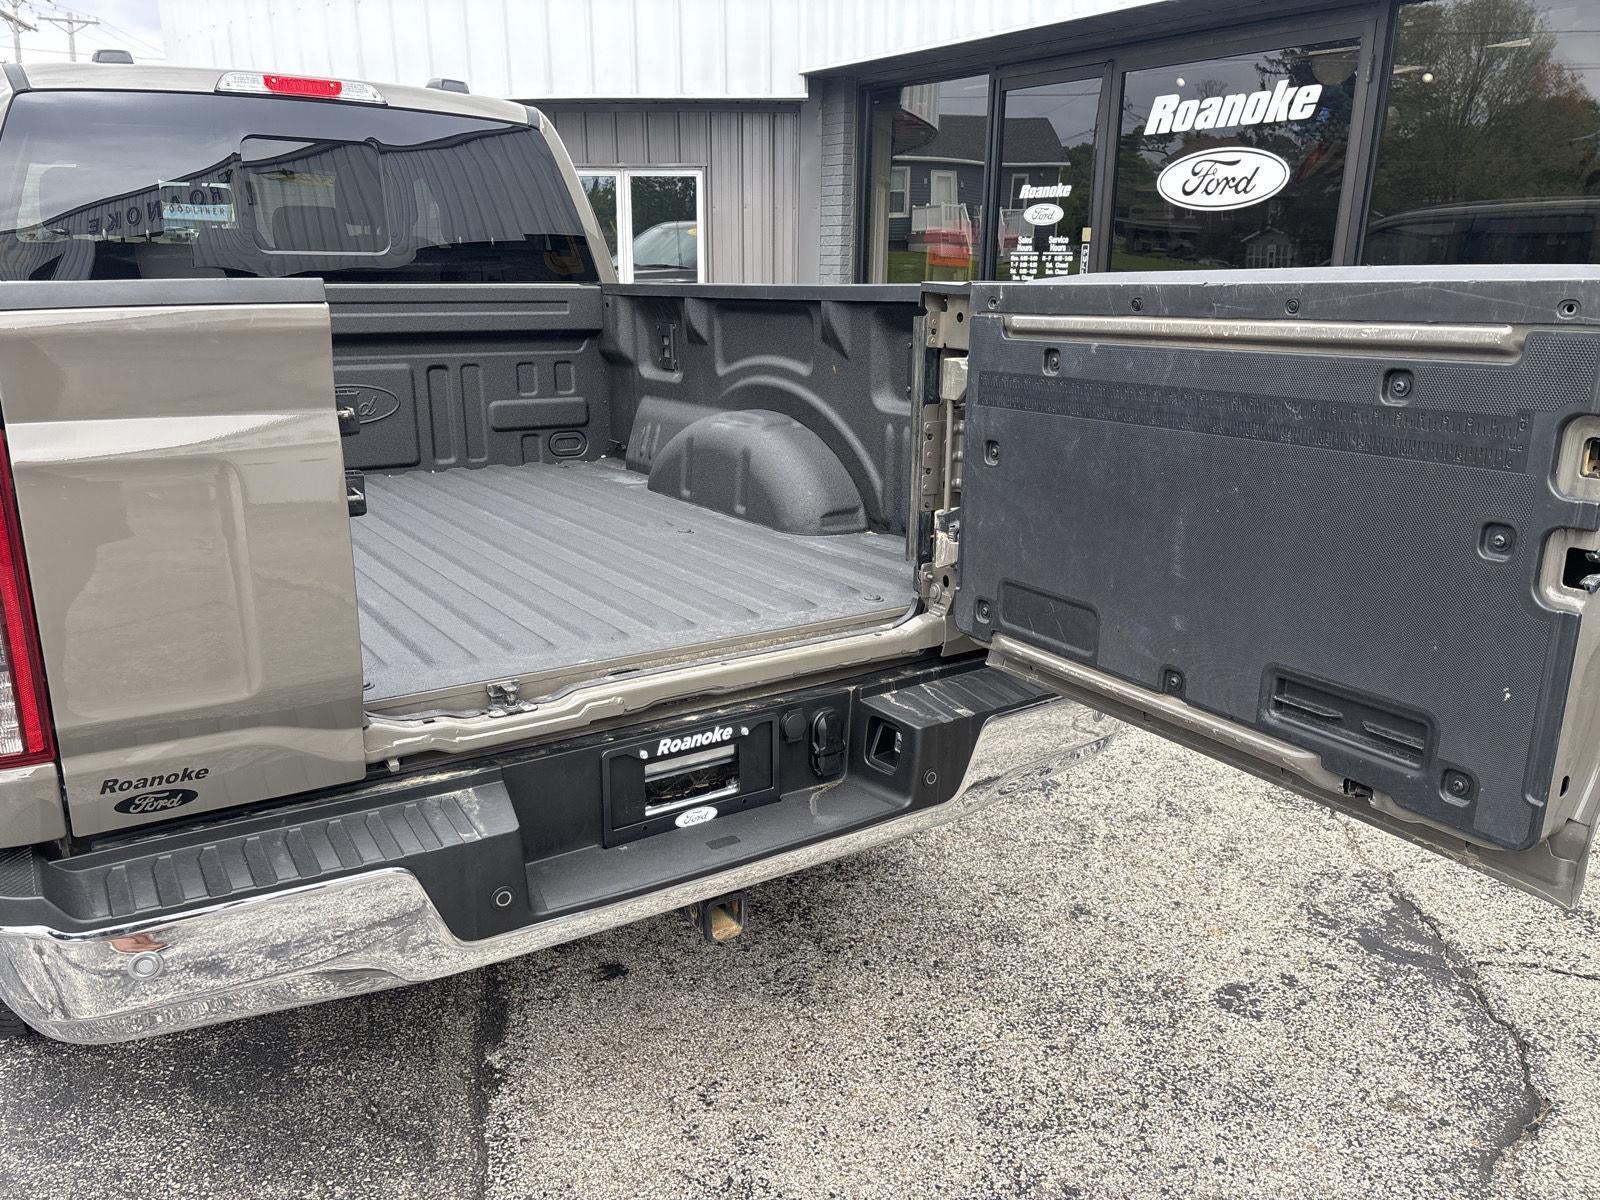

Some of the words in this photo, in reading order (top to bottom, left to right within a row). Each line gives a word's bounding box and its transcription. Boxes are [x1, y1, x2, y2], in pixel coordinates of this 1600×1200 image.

[1143, 79, 1323, 135] Roanoke
[1181, 159, 1260, 197] Ford
[1019, 183, 1072, 199] Roanoke
[167, 204, 225, 216] OODLINER
[1032, 208, 1054, 220] Ford
[1018, 236, 1033, 244] Sales
[1048, 235, 1069, 244] Service
[656, 726, 733, 756] Roanoke
[100, 767, 209, 795] Roanoke
[129, 791, 182, 814] Ford
[684, 810, 709, 824] Ford
